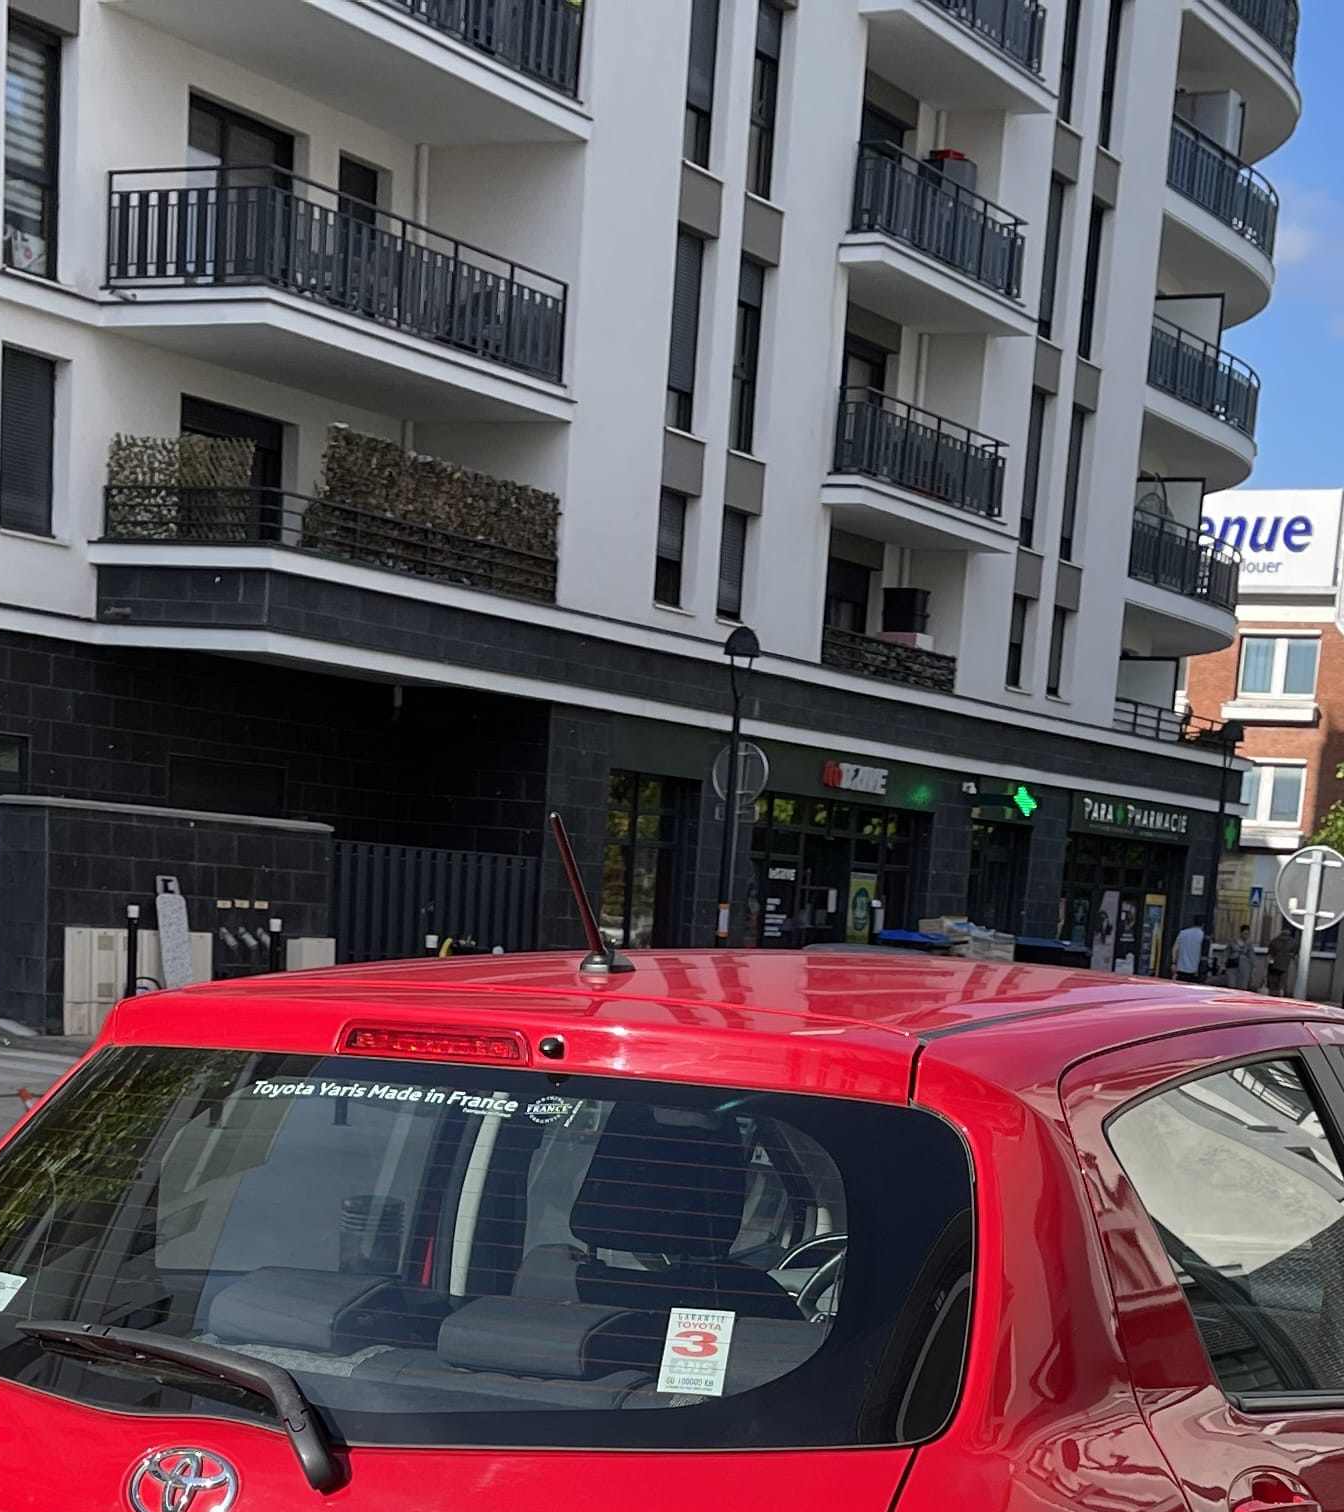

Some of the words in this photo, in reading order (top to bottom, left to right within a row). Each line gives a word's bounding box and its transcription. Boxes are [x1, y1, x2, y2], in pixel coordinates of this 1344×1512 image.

[252, 1080, 314, 1098] Toyota
[319, 1082, 367, 1098] Yaris
[367, 1085, 422, 1102] Made
[425, 1088, 445, 1104] in
[447, 1091, 519, 1112] France
[526, 1103, 569, 1113] FRANCE
[677, 1313, 727, 1323] GARANTIE
[676, 1321, 722, 1331] TOYOTA
[671, 1330, 719, 1357] 3
